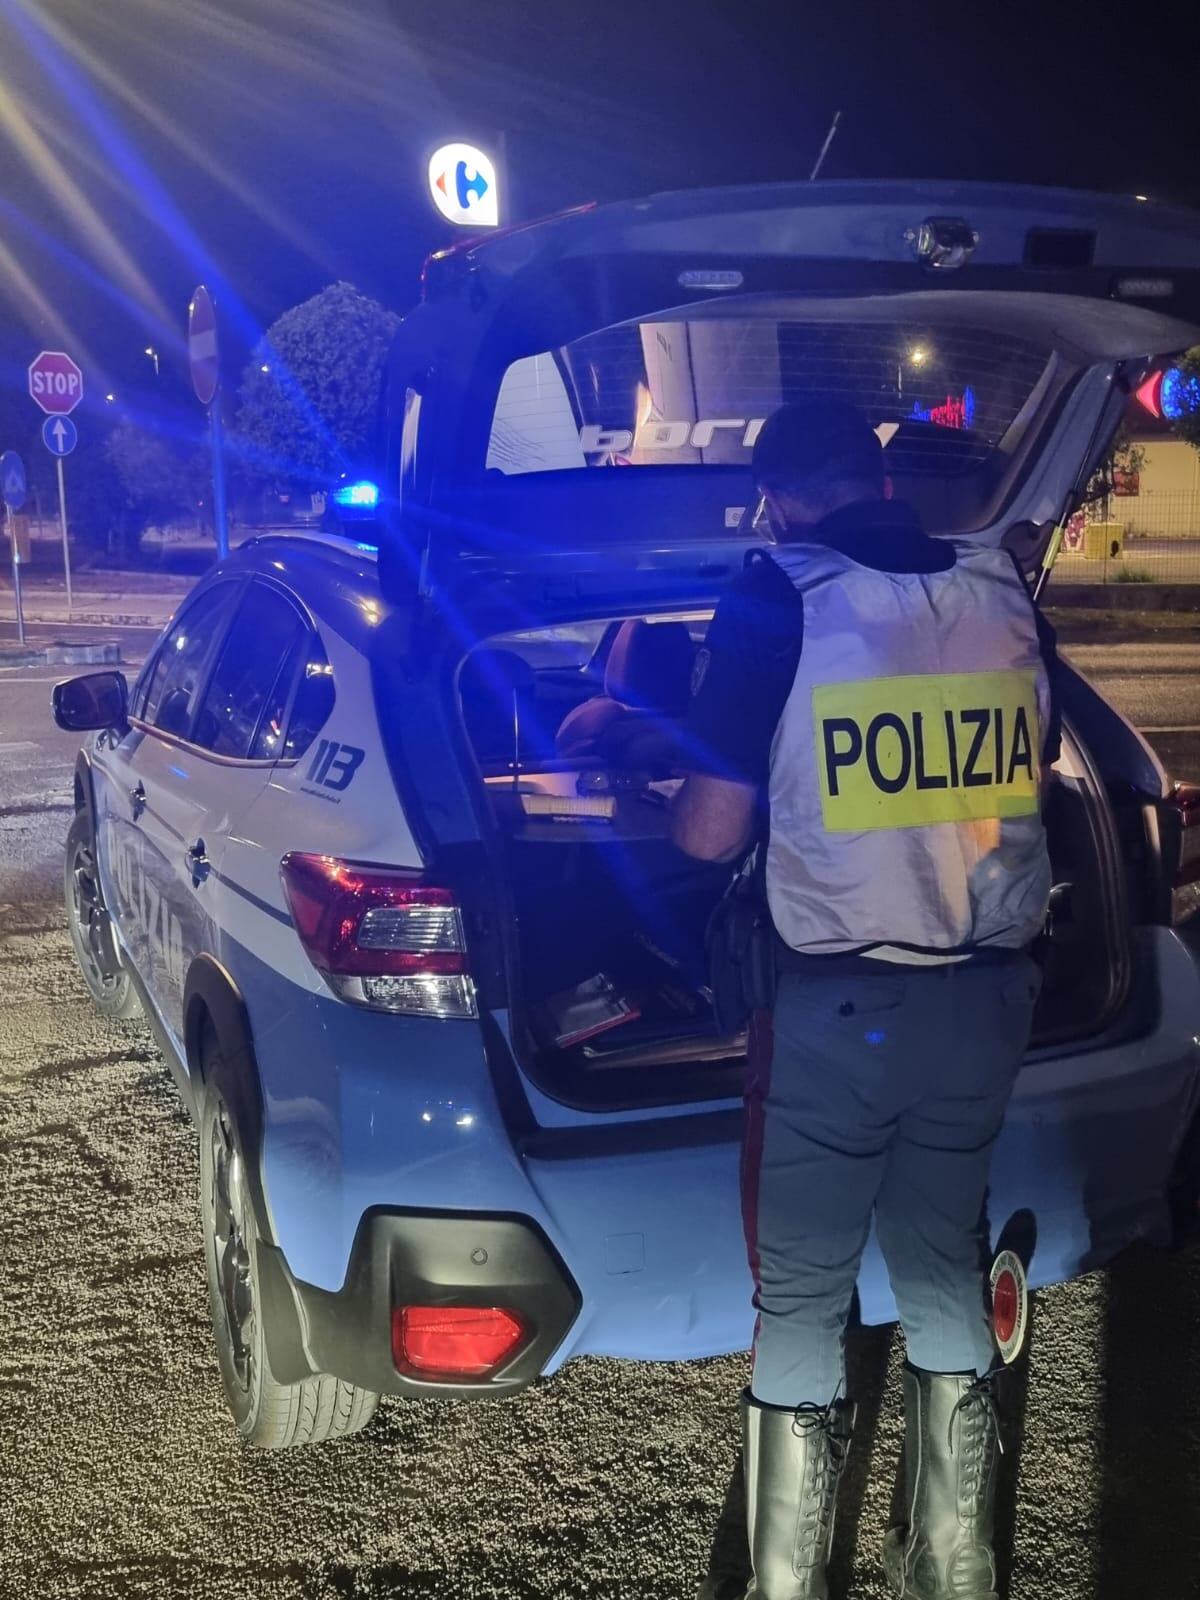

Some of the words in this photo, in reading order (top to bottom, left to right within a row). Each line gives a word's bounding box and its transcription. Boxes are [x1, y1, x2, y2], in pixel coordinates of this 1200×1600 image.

[33, 371, 79, 395] STOP
[305, 739, 366, 792] 113
[822, 706, 1034, 796] POLIZIA
